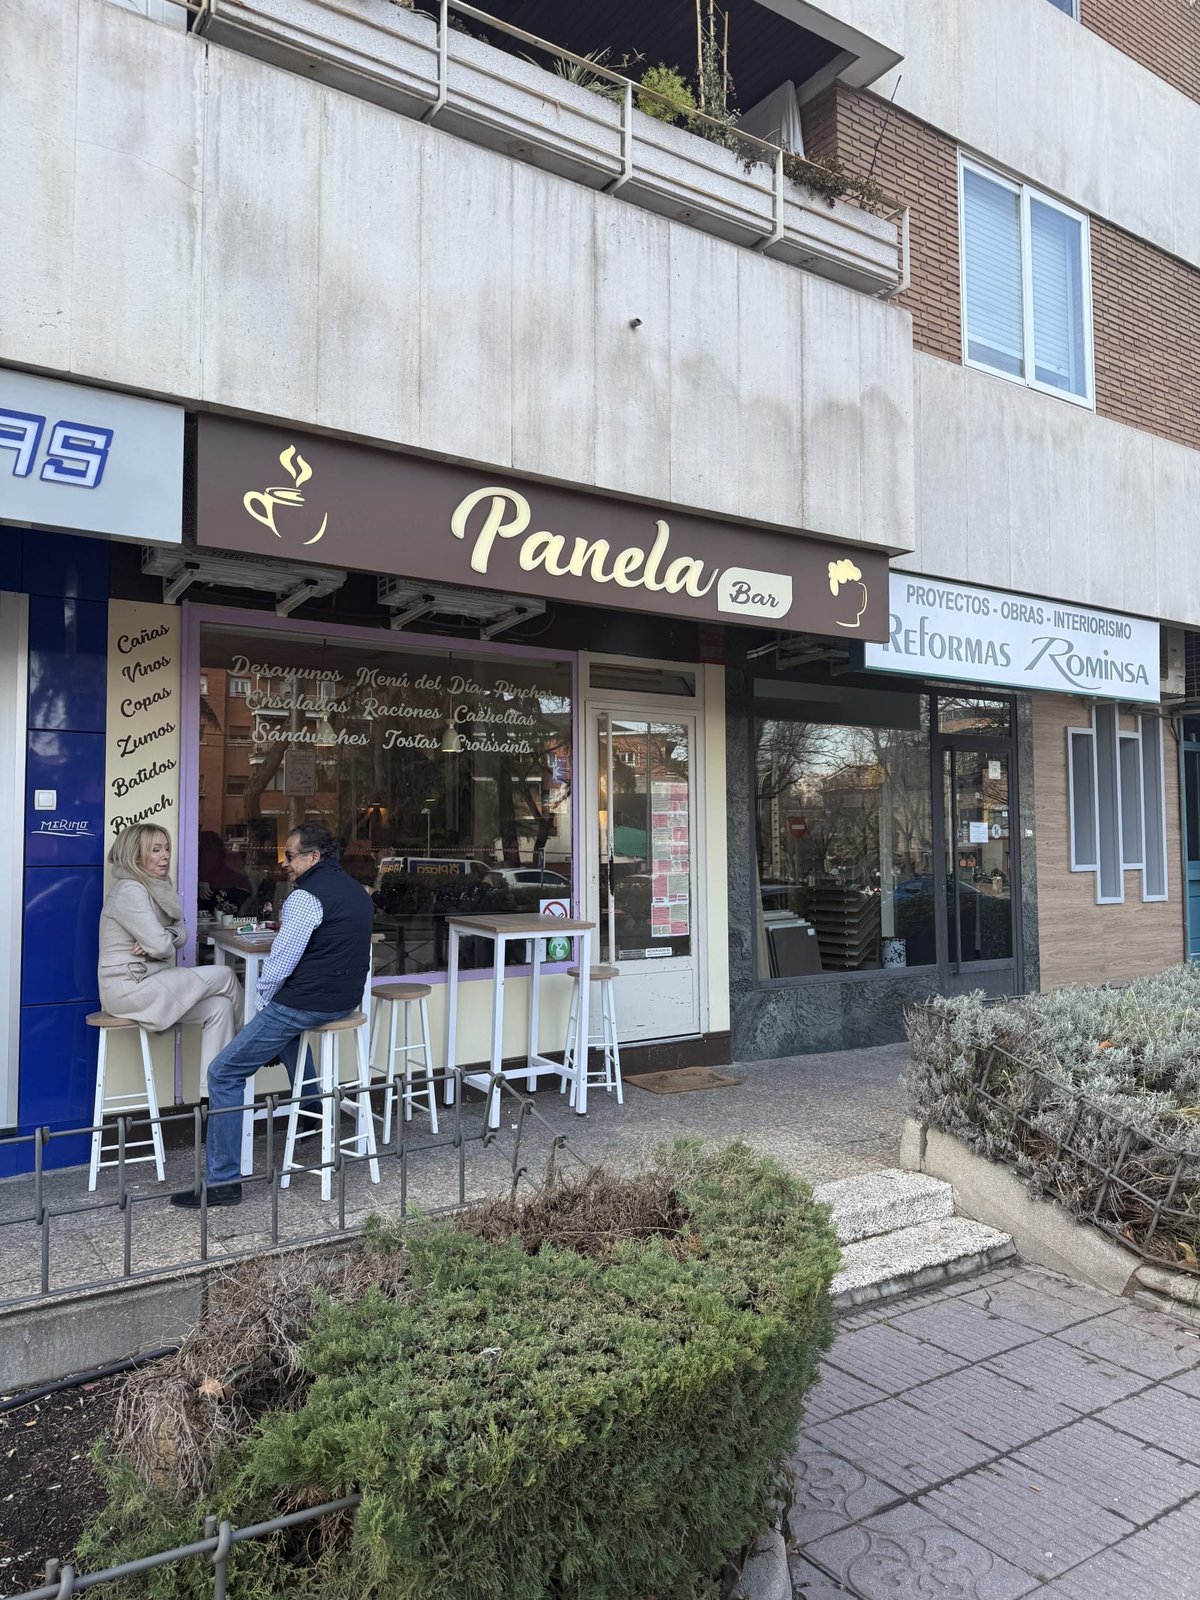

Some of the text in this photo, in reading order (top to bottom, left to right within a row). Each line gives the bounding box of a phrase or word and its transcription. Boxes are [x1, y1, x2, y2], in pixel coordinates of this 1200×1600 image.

[450, 486, 719, 598] Panela
[729, 580, 780, 609] Bar
[906, 584, 990, 617] PROYECTOS
[1001, 601, 1044, 625] OBRAS
[1053, 610, 1132, 640] INTERIORISMO
[117, 624, 170, 654] Cañas
[122, 656, 171, 683] Vinos
[226, 654, 554, 699] Desayunos Menú del Día Pinchos
[120, 687, 172, 718] Copas
[245, 688, 537, 726] Ensaladas Raciones Cazuelitas
[116, 722, 176, 758] Zumos
[251, 722, 535, 753] Sándwiches Tostas Croissants
[111, 759, 177, 798] Batidos
[110, 794, 174, 836] Brunch
